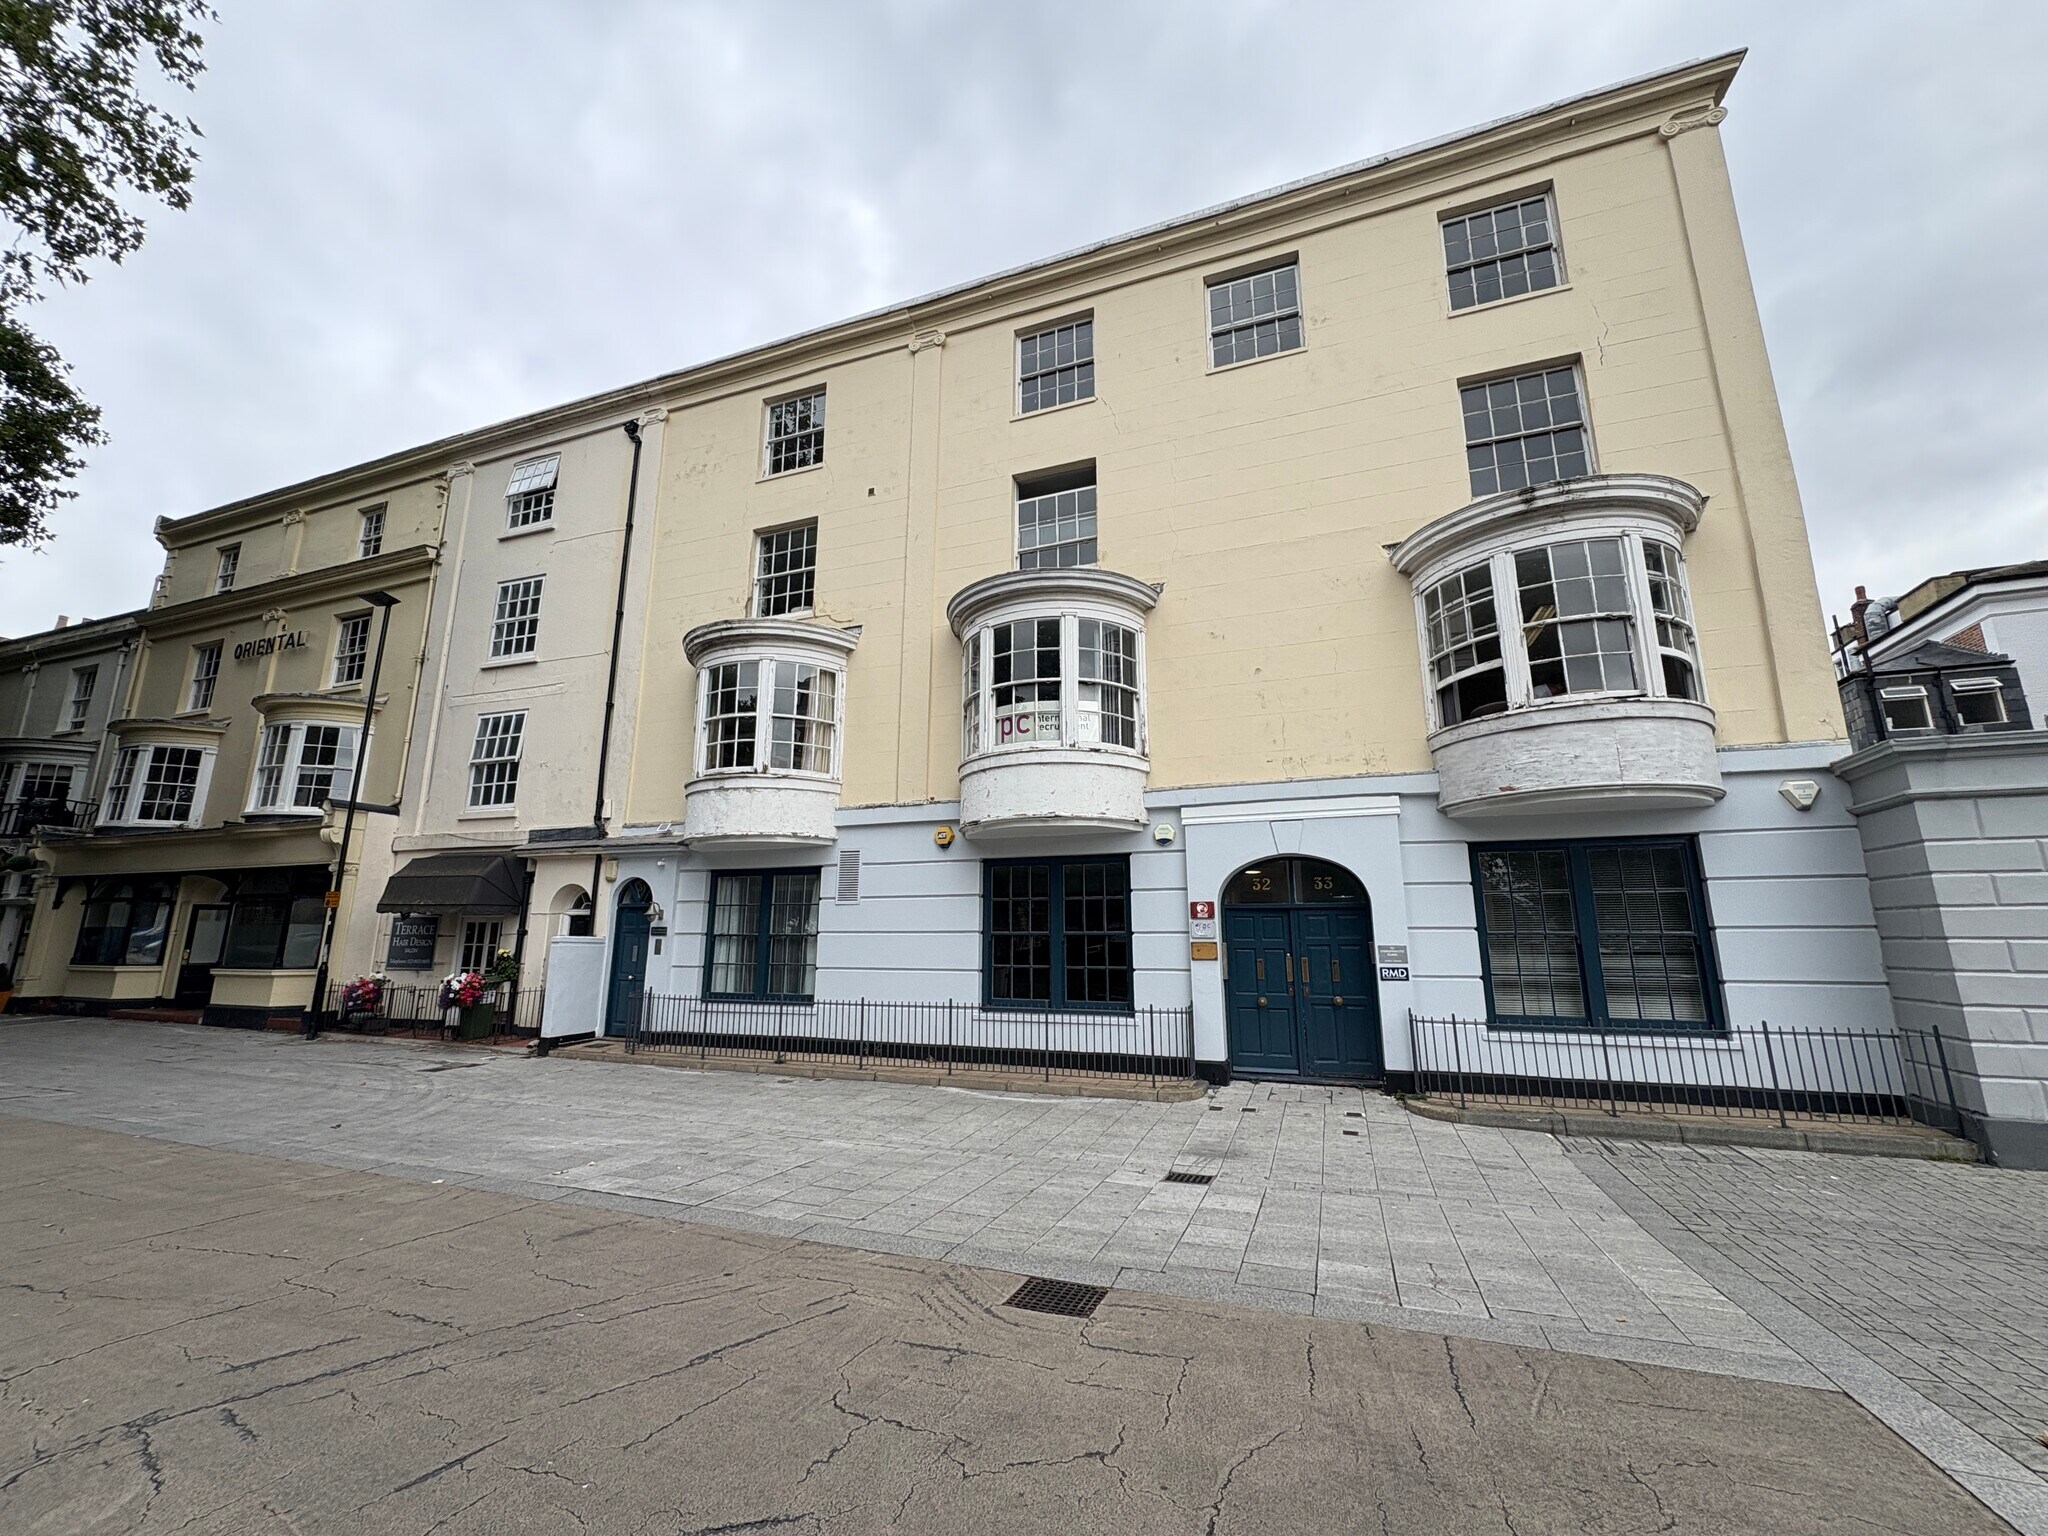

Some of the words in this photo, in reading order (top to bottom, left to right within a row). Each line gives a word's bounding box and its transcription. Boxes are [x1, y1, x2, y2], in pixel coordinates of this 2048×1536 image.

[234, 630, 306, 660] ORIENTAL
[1252, 877, 1271, 891] 32
[1313, 876, 1333, 890] 33
[394, 921, 436, 935] TERRACE
[392, 936, 409, 947] HAIR
[410, 936, 433, 947] DESIGN
[1381, 968, 1408, 978] RMD
